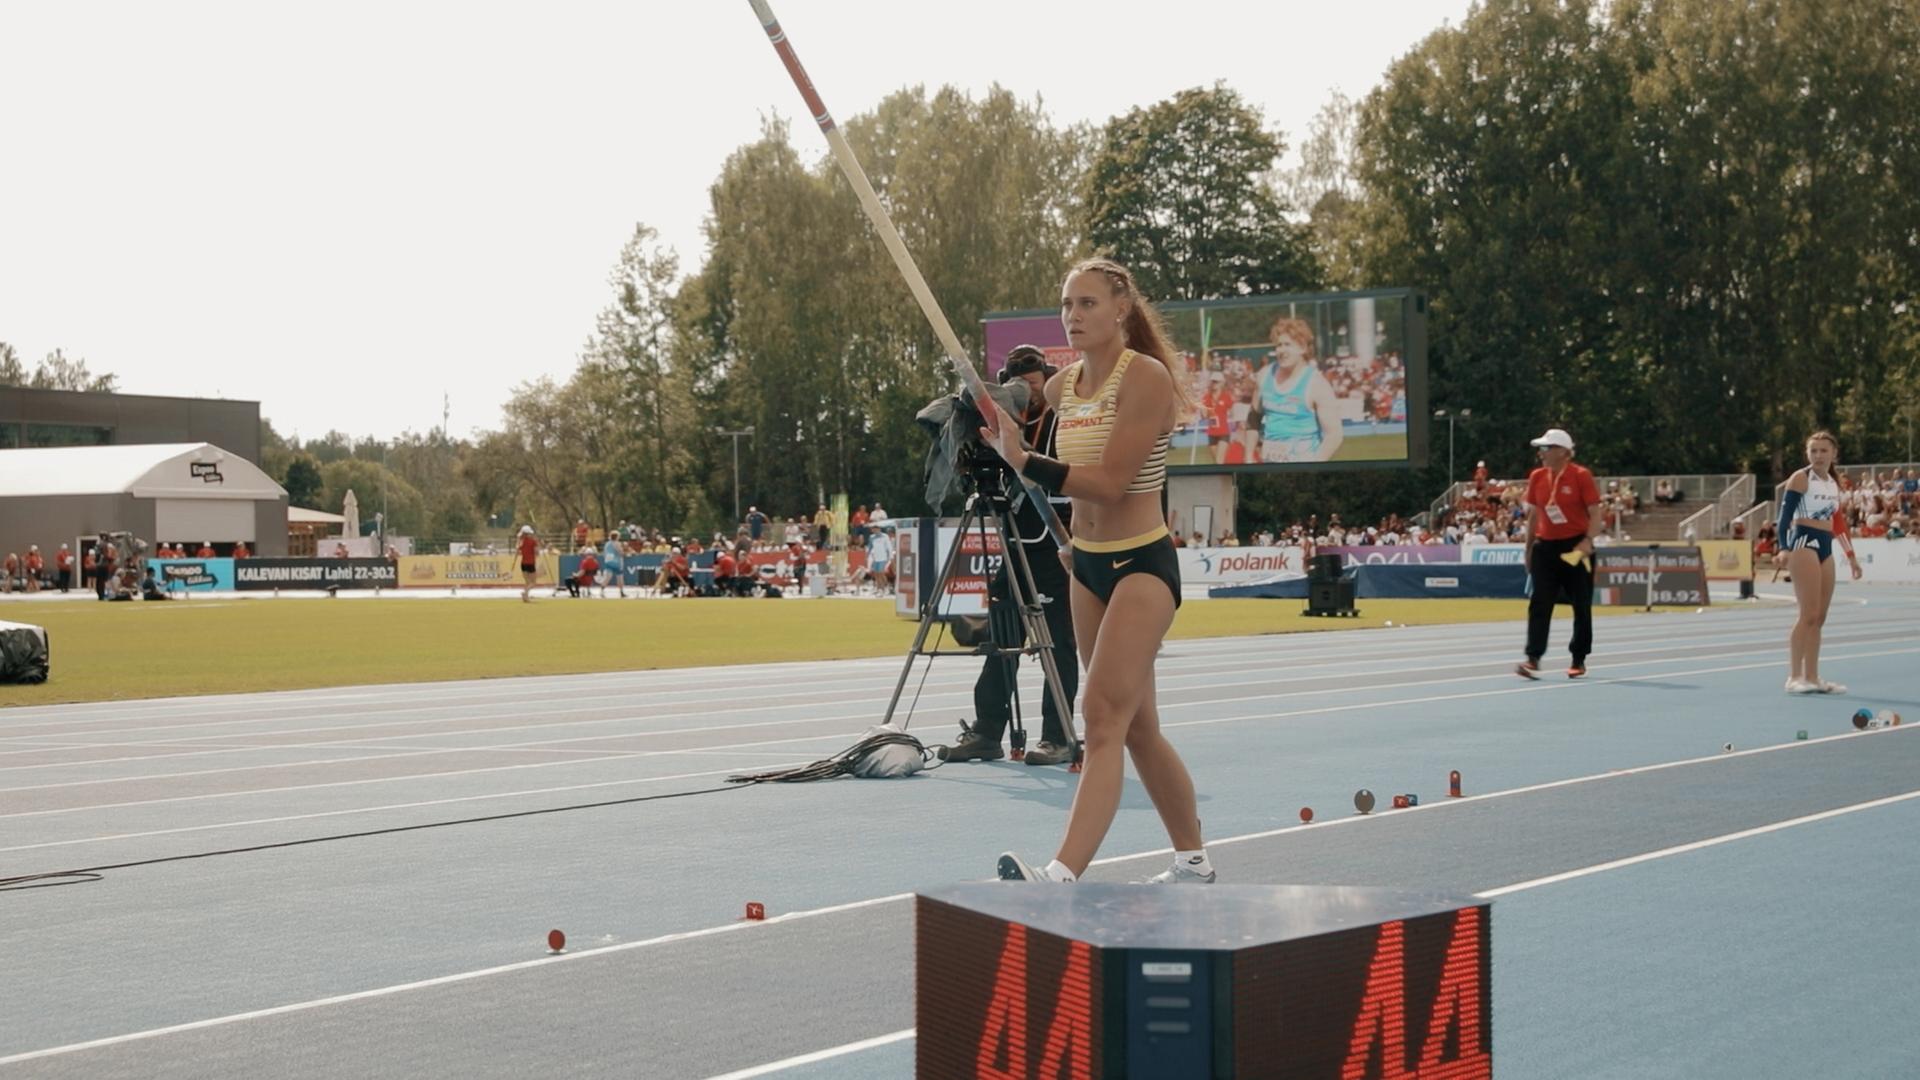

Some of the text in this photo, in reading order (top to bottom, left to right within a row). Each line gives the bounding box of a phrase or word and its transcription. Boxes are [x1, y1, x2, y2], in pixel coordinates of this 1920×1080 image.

[1060, 416, 1104, 430] GERMANY
[1219, 552, 1290, 576] polanik
[238, 567, 290, 581] KALEVAN
[291, 567, 323, 580] KISAT
[325, 565, 353, 580] Lahti
[1609, 572, 1662, 584] ITALY
